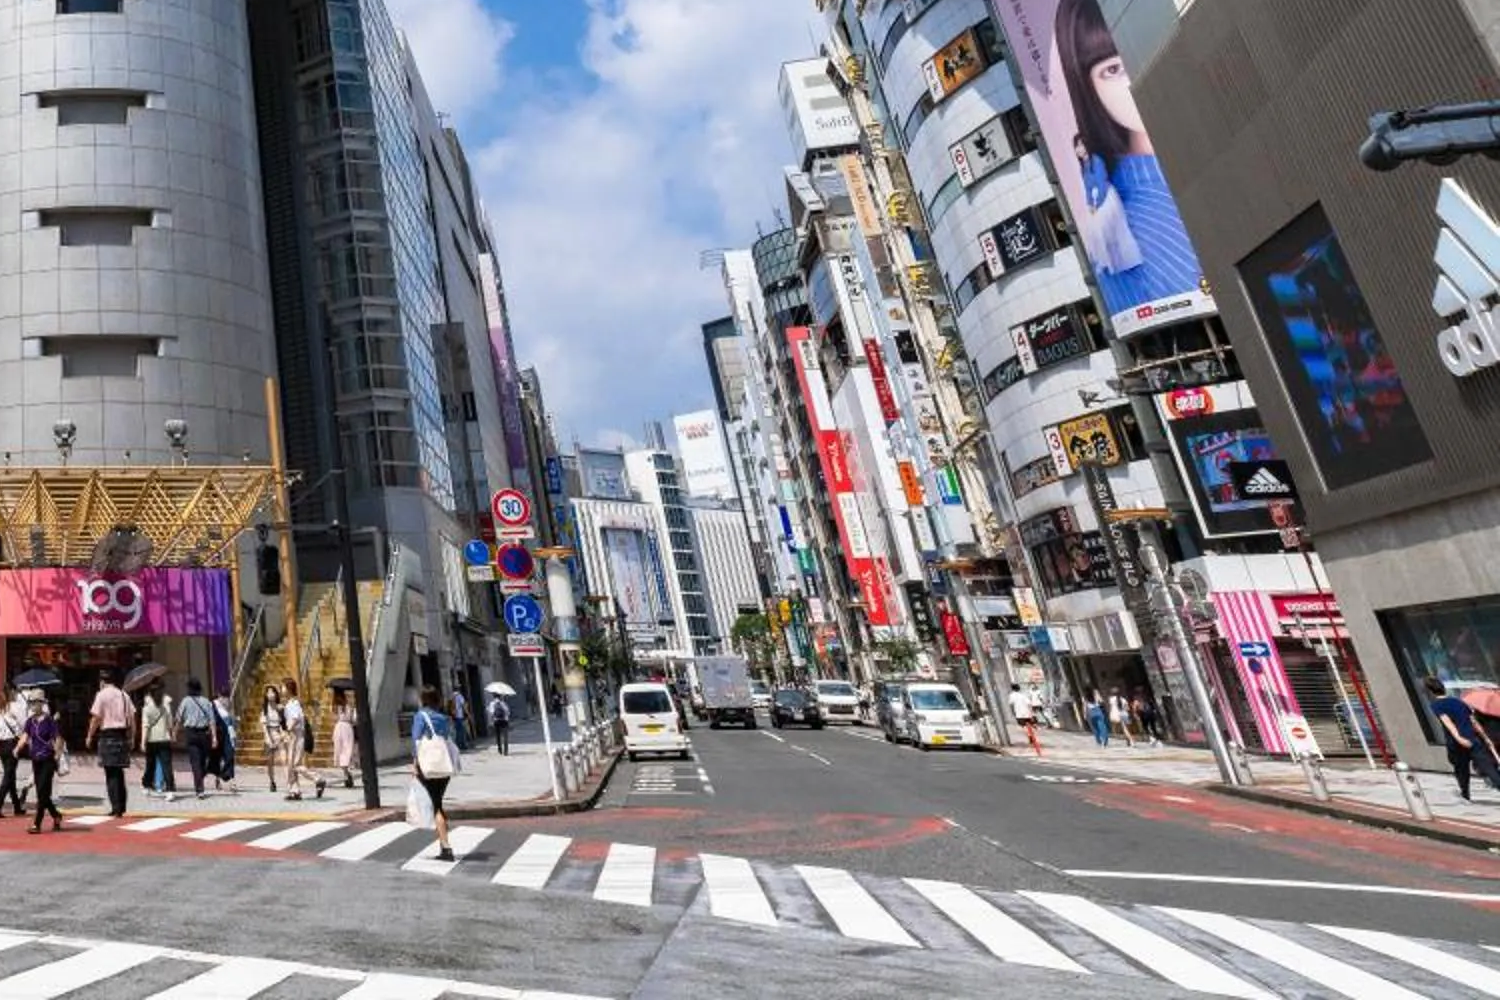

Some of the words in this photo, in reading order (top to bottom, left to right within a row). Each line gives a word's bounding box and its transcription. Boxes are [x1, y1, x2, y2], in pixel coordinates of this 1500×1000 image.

[1245, 483, 1290, 494] adidas
[501, 499, 522, 517] 30
[76, 579, 141, 630] 109
[512, 604, 527, 630] P
